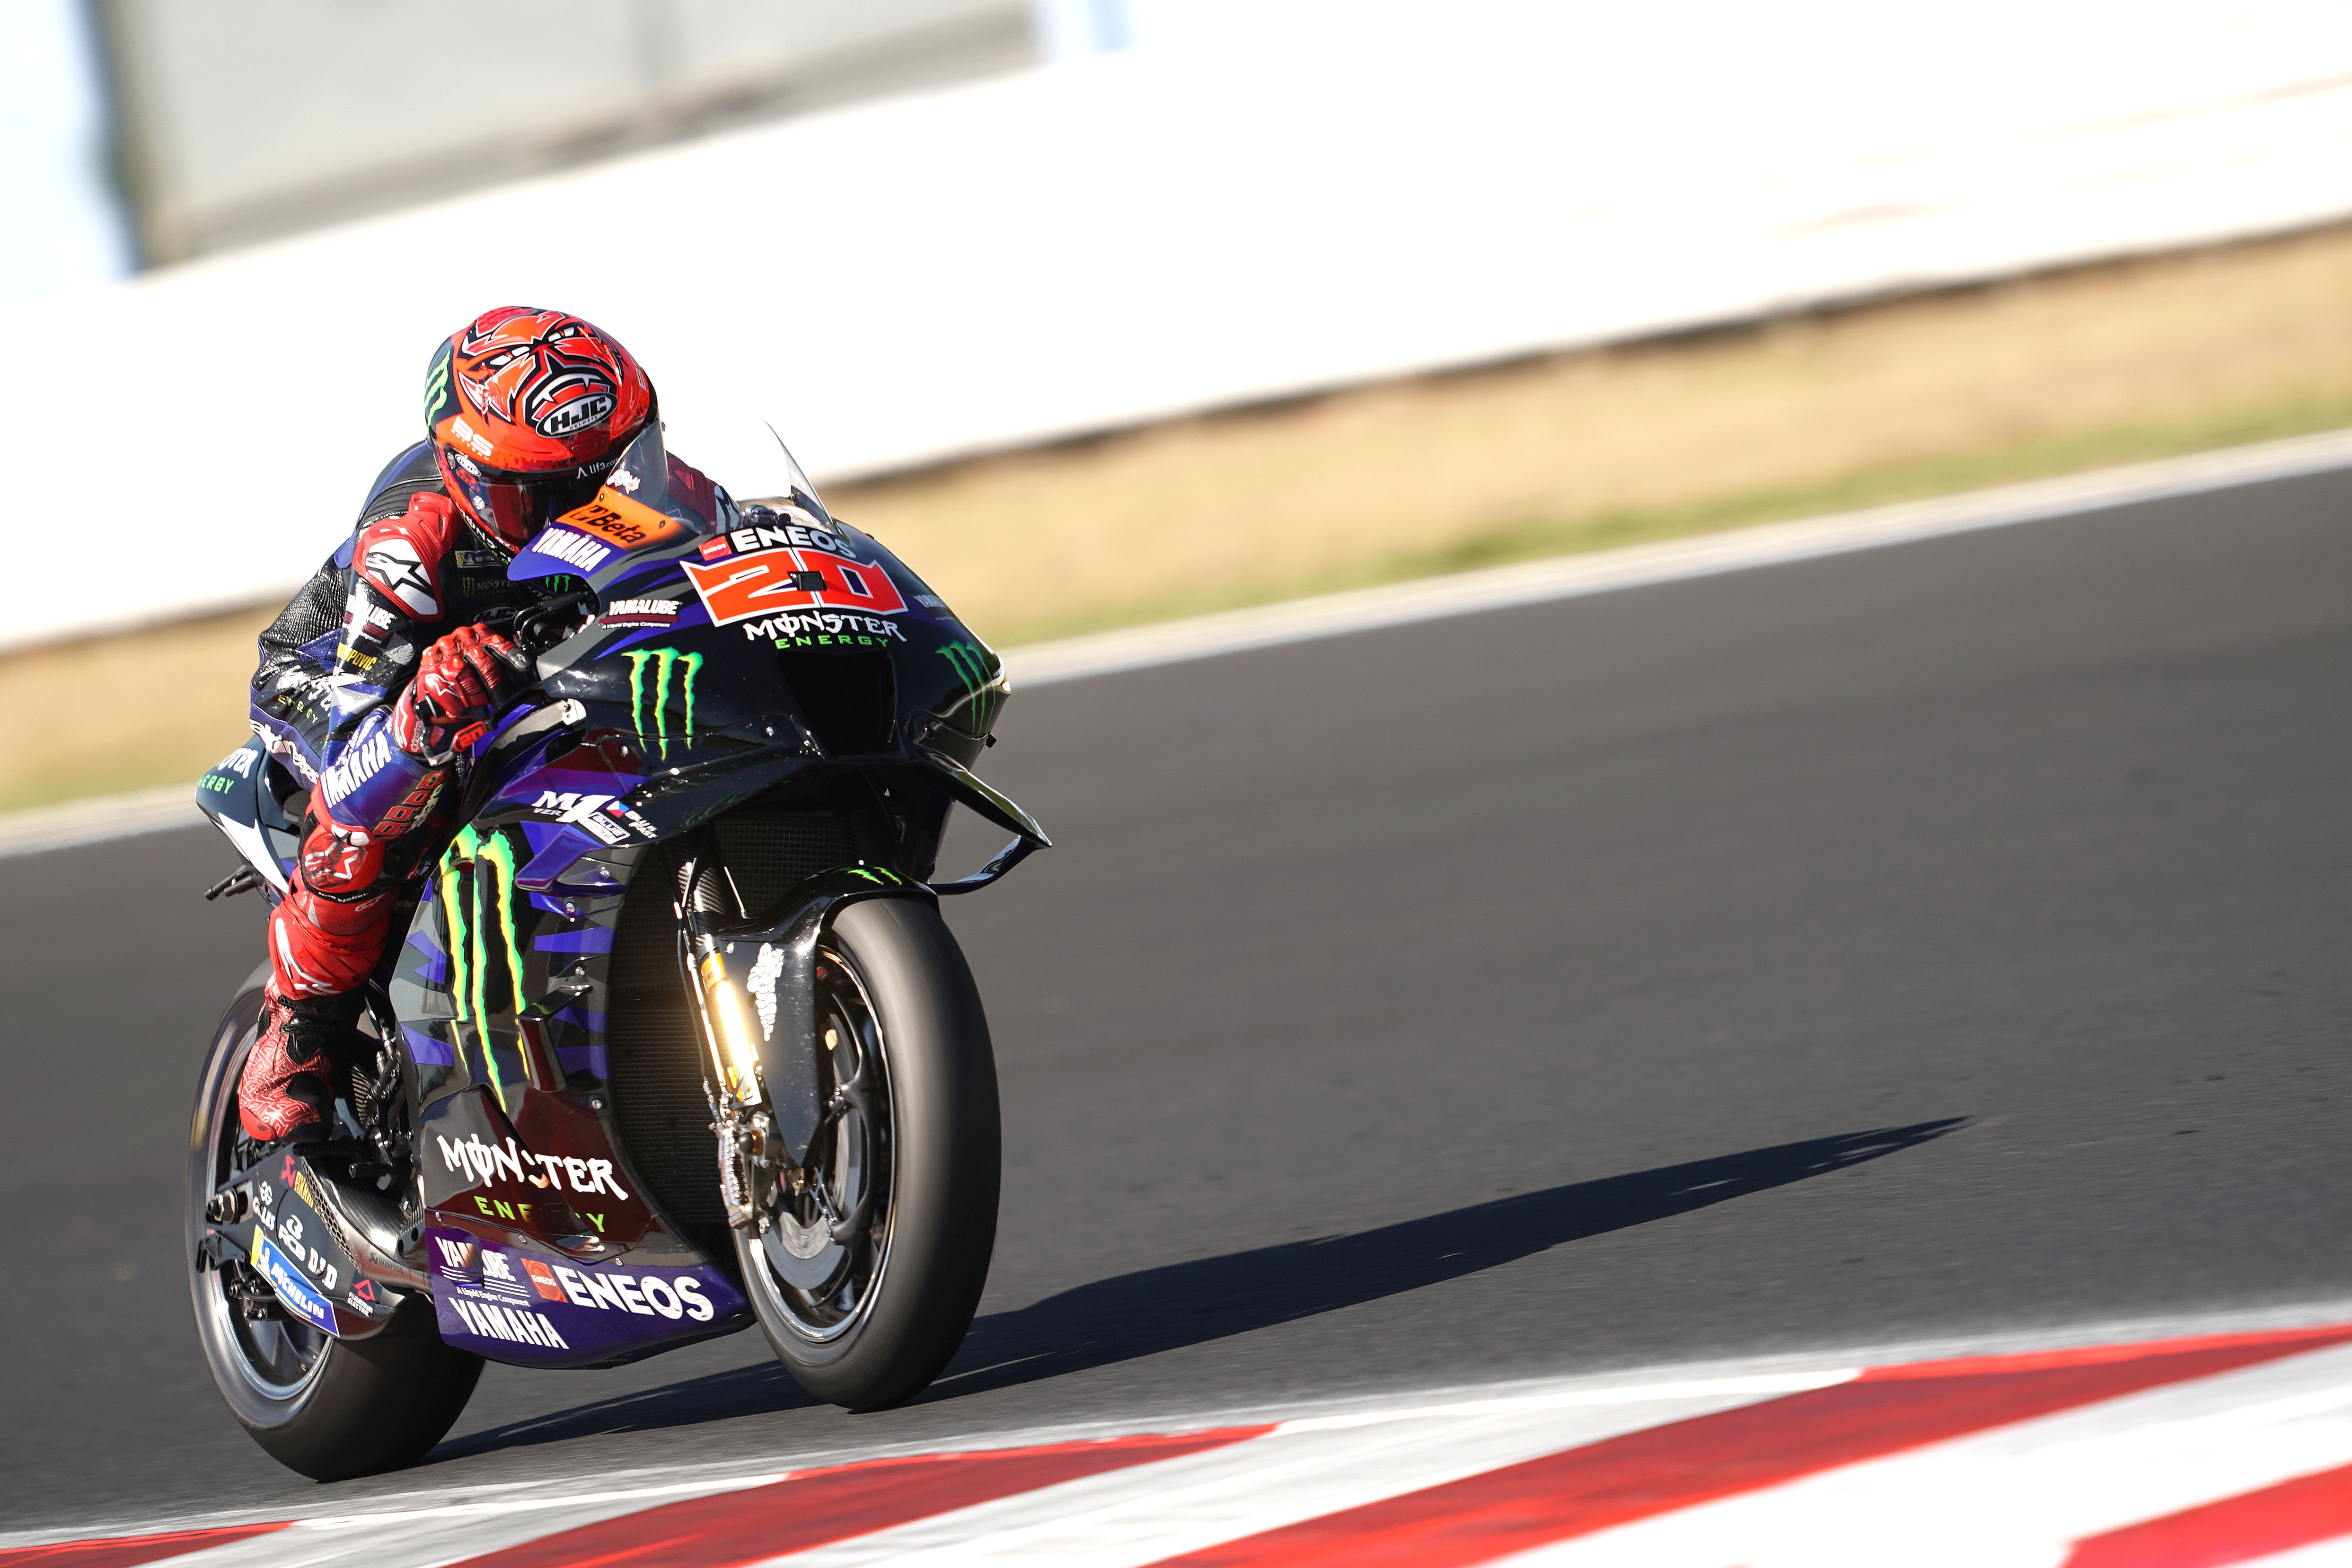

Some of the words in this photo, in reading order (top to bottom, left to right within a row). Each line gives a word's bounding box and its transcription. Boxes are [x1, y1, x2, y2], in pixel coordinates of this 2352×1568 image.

[550, 396, 607, 432] HJC
[452, 416, 493, 456] BS
[586, 512, 646, 543] Beta
[730, 525, 856, 559] ENEOS
[532, 528, 611, 572] YAMAHA
[703, 544, 727, 555] ENEOS
[679, 547, 908, 627] 20
[609, 599, 679, 616] YAMALUBE
[743, 610, 907, 642] MONSTER
[775, 635, 889, 650] ENERGY
[531, 791, 616, 823] M1
[625, 810, 657, 831] BLUE
[592, 814, 625, 837] BLUE
[628, 822, 658, 838] FAST
[474, 1196, 606, 1232] ENEY
[279, 1224, 306, 1261] RCB
[270, 1262, 325, 1320] MICHELIN
[456, 1286, 462, 1295] A
[462, 1287, 480, 1298] Liquid
[480, 1290, 498, 1301] Engine
[497, 1294, 531, 1307] Component
[530, 1274, 557, 1287] ENEOS
[552, 1265, 714, 1321] ENEOS
[347, 1298, 370, 1317] ELECTRIC
[448, 1297, 570, 1350] YAMAHA
